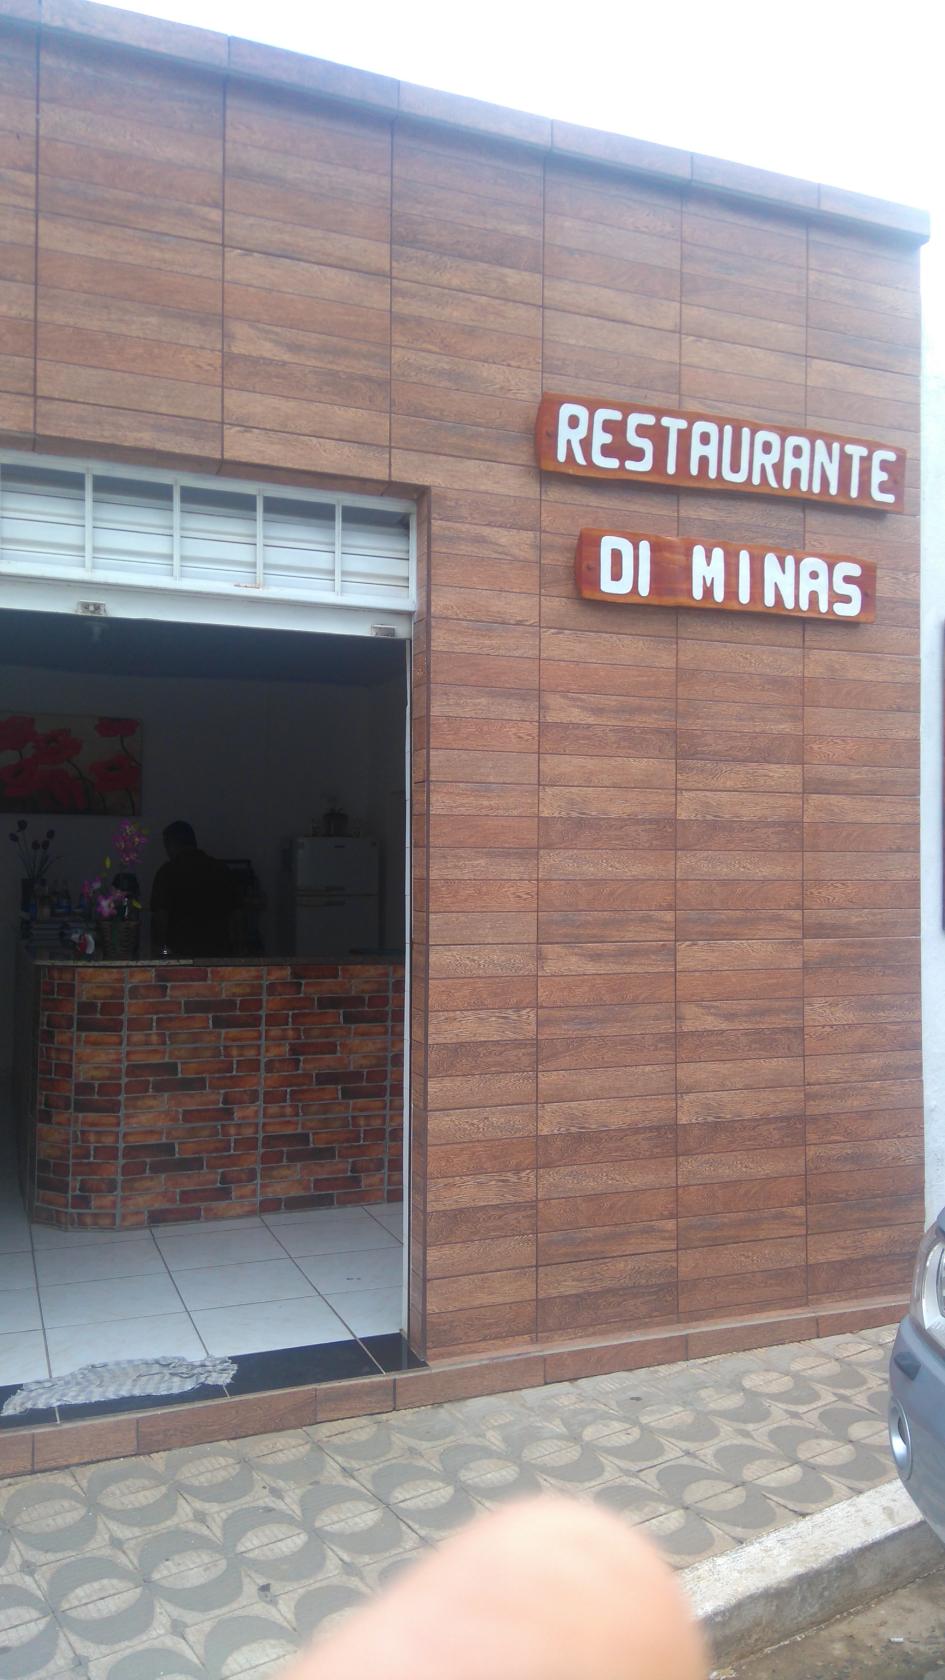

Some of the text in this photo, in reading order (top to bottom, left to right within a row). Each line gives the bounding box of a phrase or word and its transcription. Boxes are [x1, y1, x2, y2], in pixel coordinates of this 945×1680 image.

[556, 402, 897, 504] RESTAURANTE
[600, 535, 862, 617] DI MINAS
